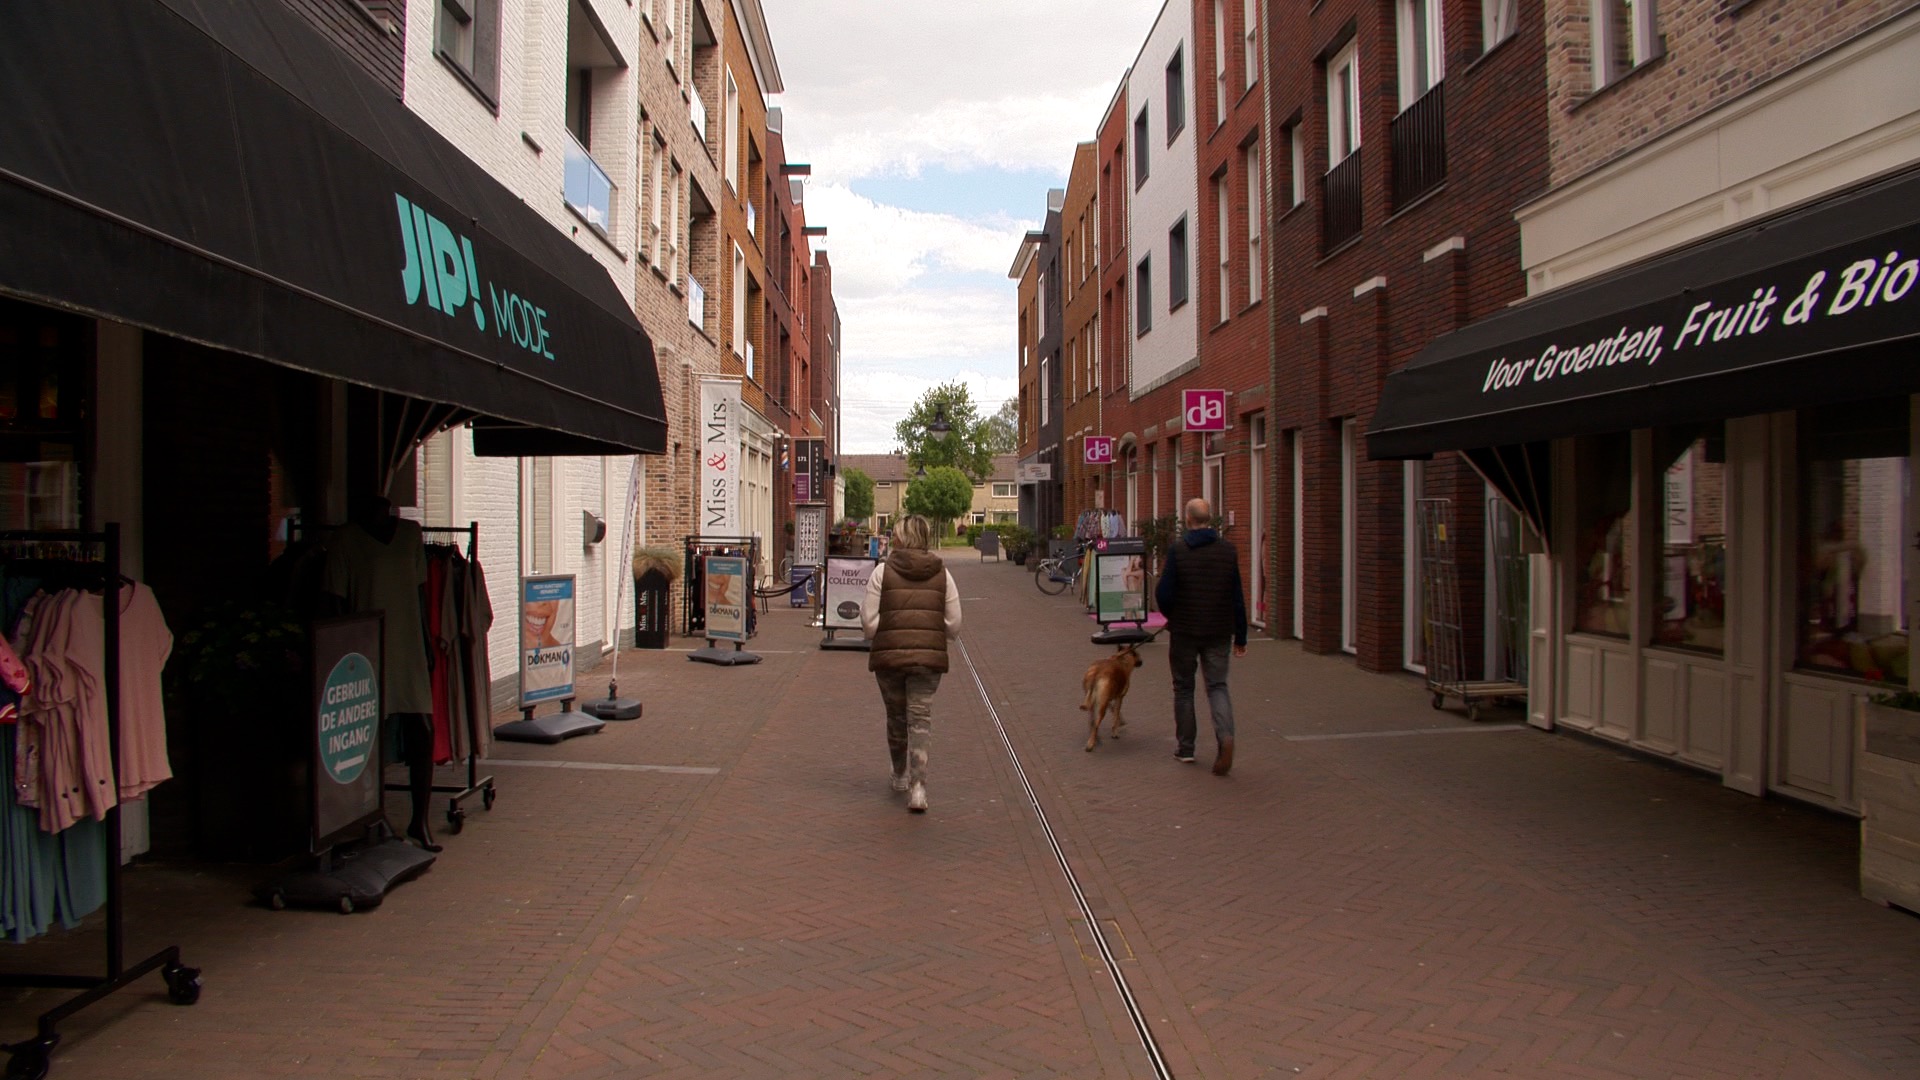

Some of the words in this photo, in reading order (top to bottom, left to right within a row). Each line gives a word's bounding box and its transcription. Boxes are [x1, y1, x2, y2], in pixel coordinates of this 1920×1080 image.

[394, 192, 486, 332] JIP!
[489, 281, 555, 361] MODE
[1482, 357, 1535, 393] Voor
[1533, 325, 1664, 382] Groenten,
[1673, 285, 1777, 351] Fruit
[1782, 270, 1826, 325] &
[1827, 251, 1919, 316] Bio
[707, 398, 727, 444] Mrs.
[1186, 395, 1222, 426] da
[707, 451, 727, 471] &
[1086, 440, 1110, 461] da
[707, 478, 727, 528] Miss
[828, 577, 868, 586] COLLECTIO
[841, 569, 860, 577] NEW
[327, 678, 371, 705] GEBRUIK
[321, 711, 336, 732] DE
[337, 700, 377, 727] ANDERE
[328, 725, 371, 755] INGANG
